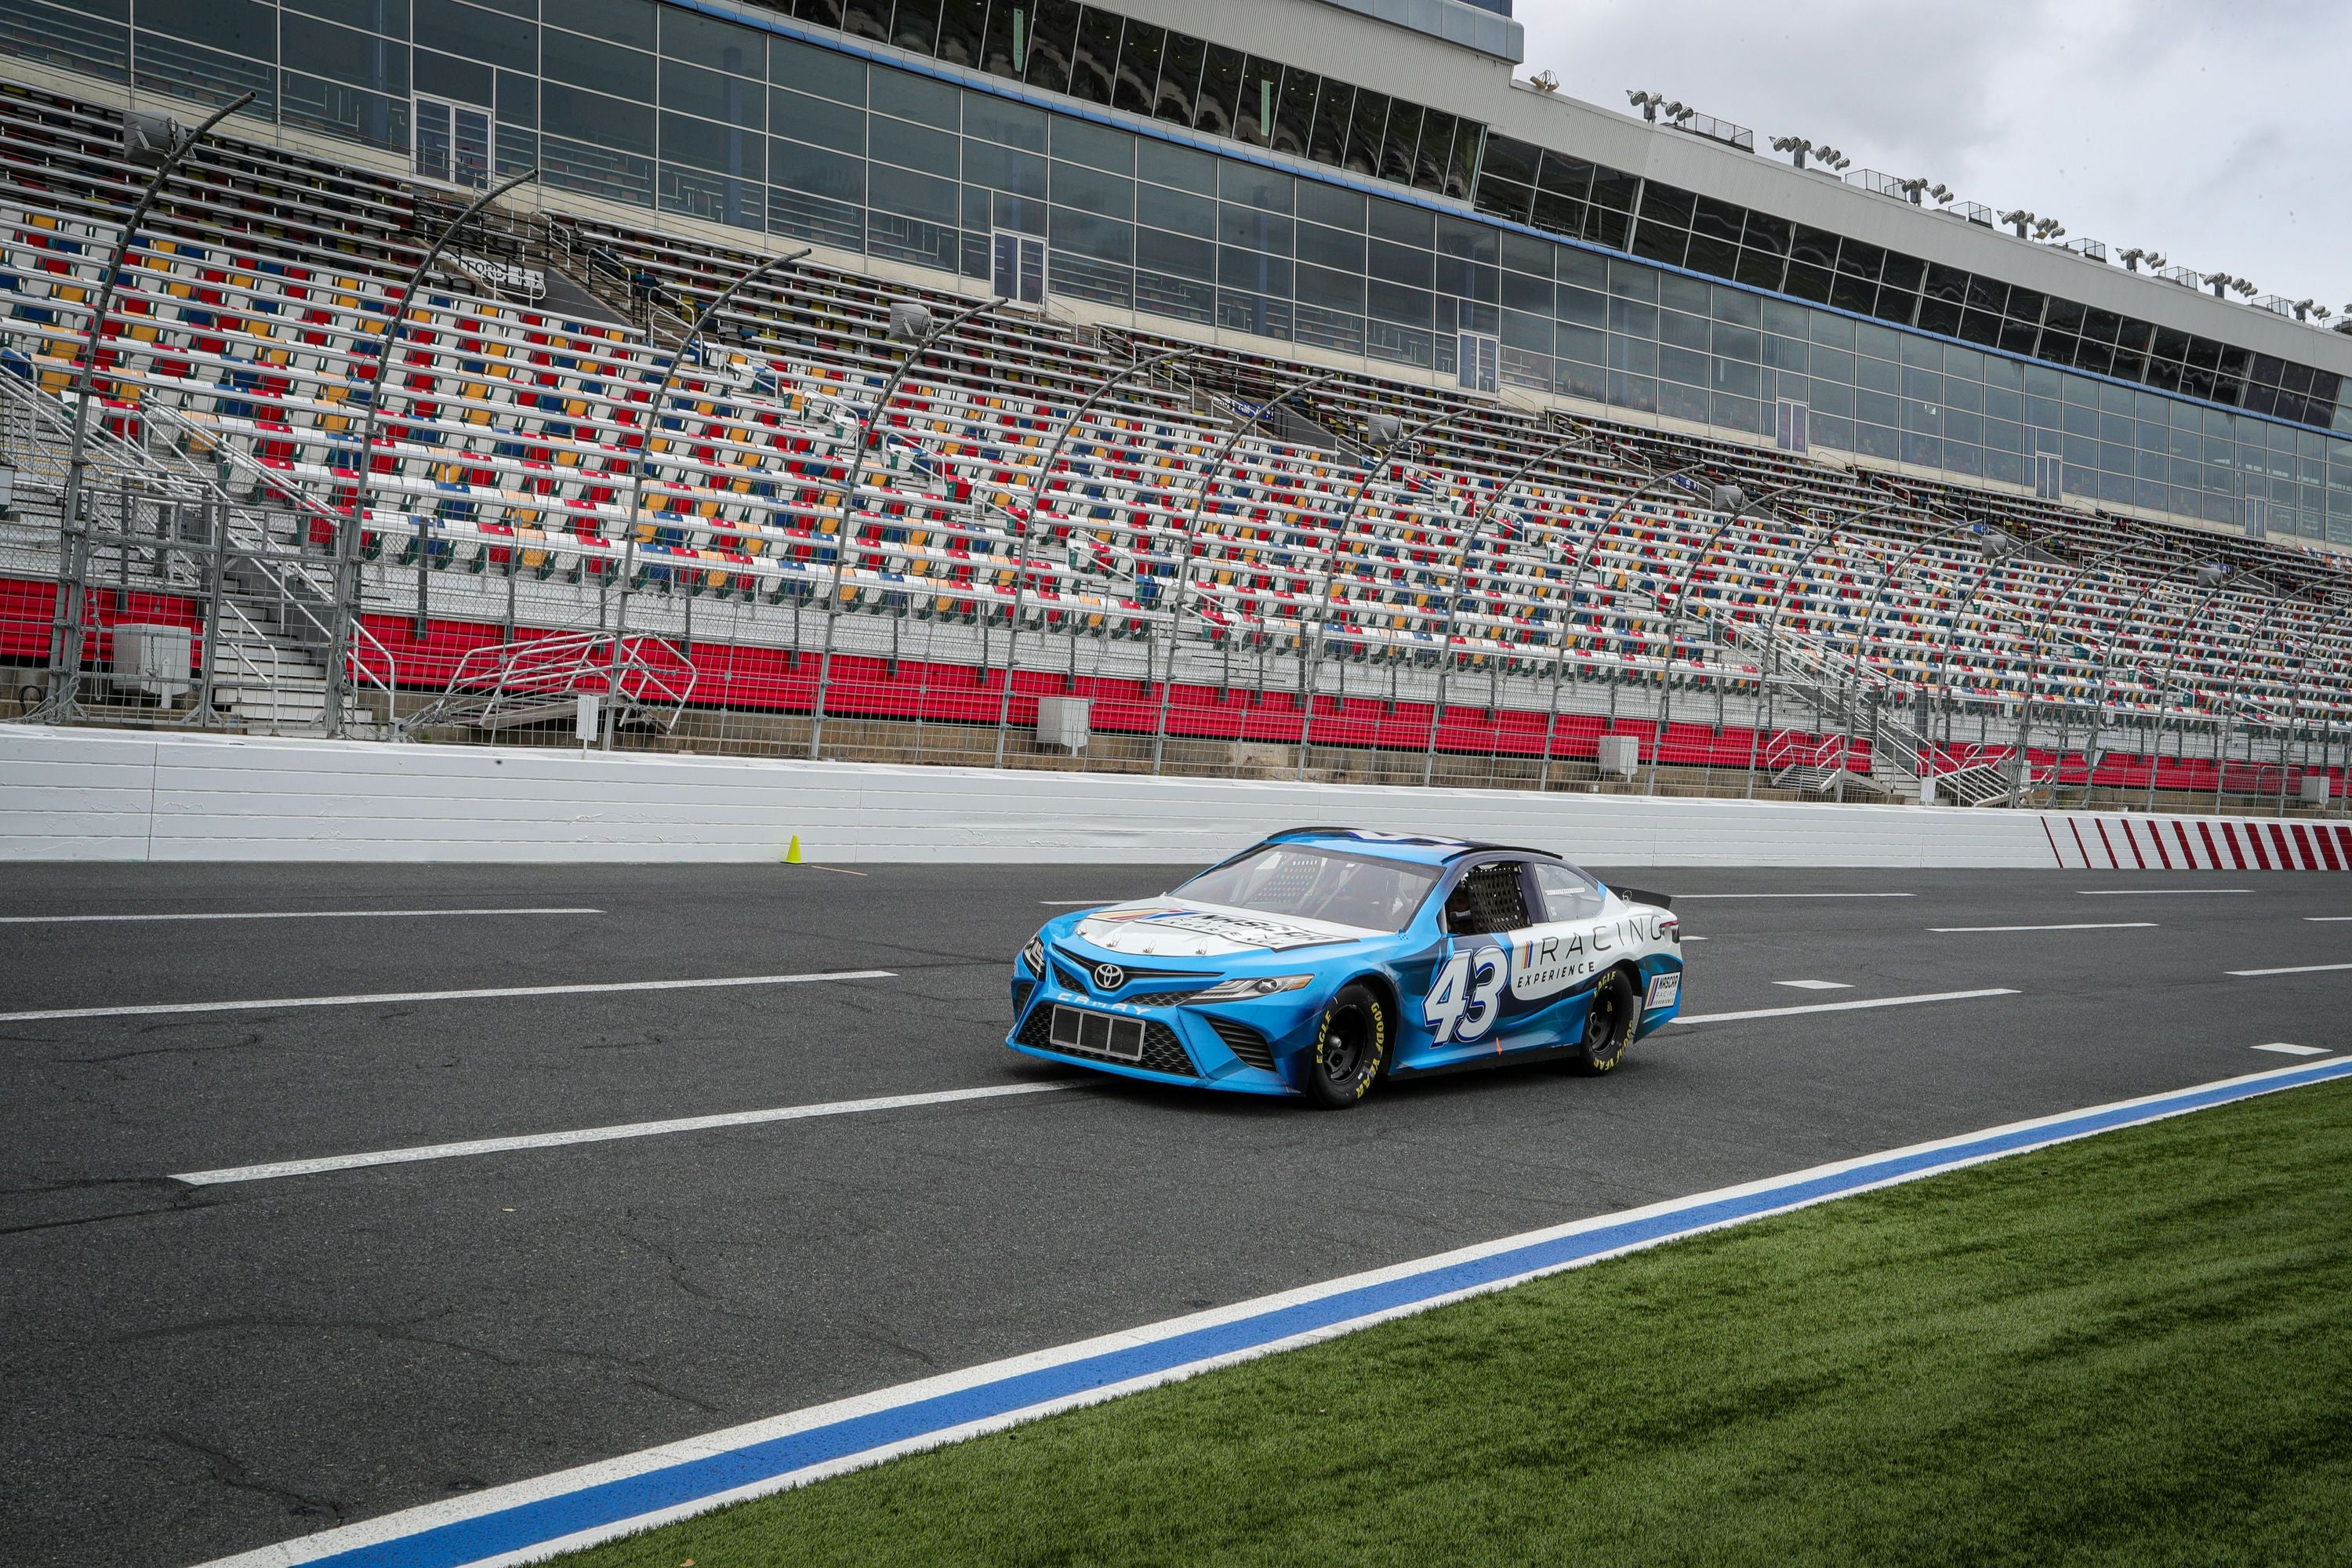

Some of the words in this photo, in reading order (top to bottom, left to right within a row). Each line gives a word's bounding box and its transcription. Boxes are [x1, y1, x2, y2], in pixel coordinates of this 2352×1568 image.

[1191, 914, 1334, 941] NASCAR
[1539, 914, 1665, 966] RACING
[1517, 961, 1595, 988] EXPERIENCE
[1658, 975, 1679, 989] NASCAR
[1421, 945, 1510, 1049] 43
[1655, 989, 1676, 998] RACING
[1316, 1010, 1332, 1064] EAGLE
